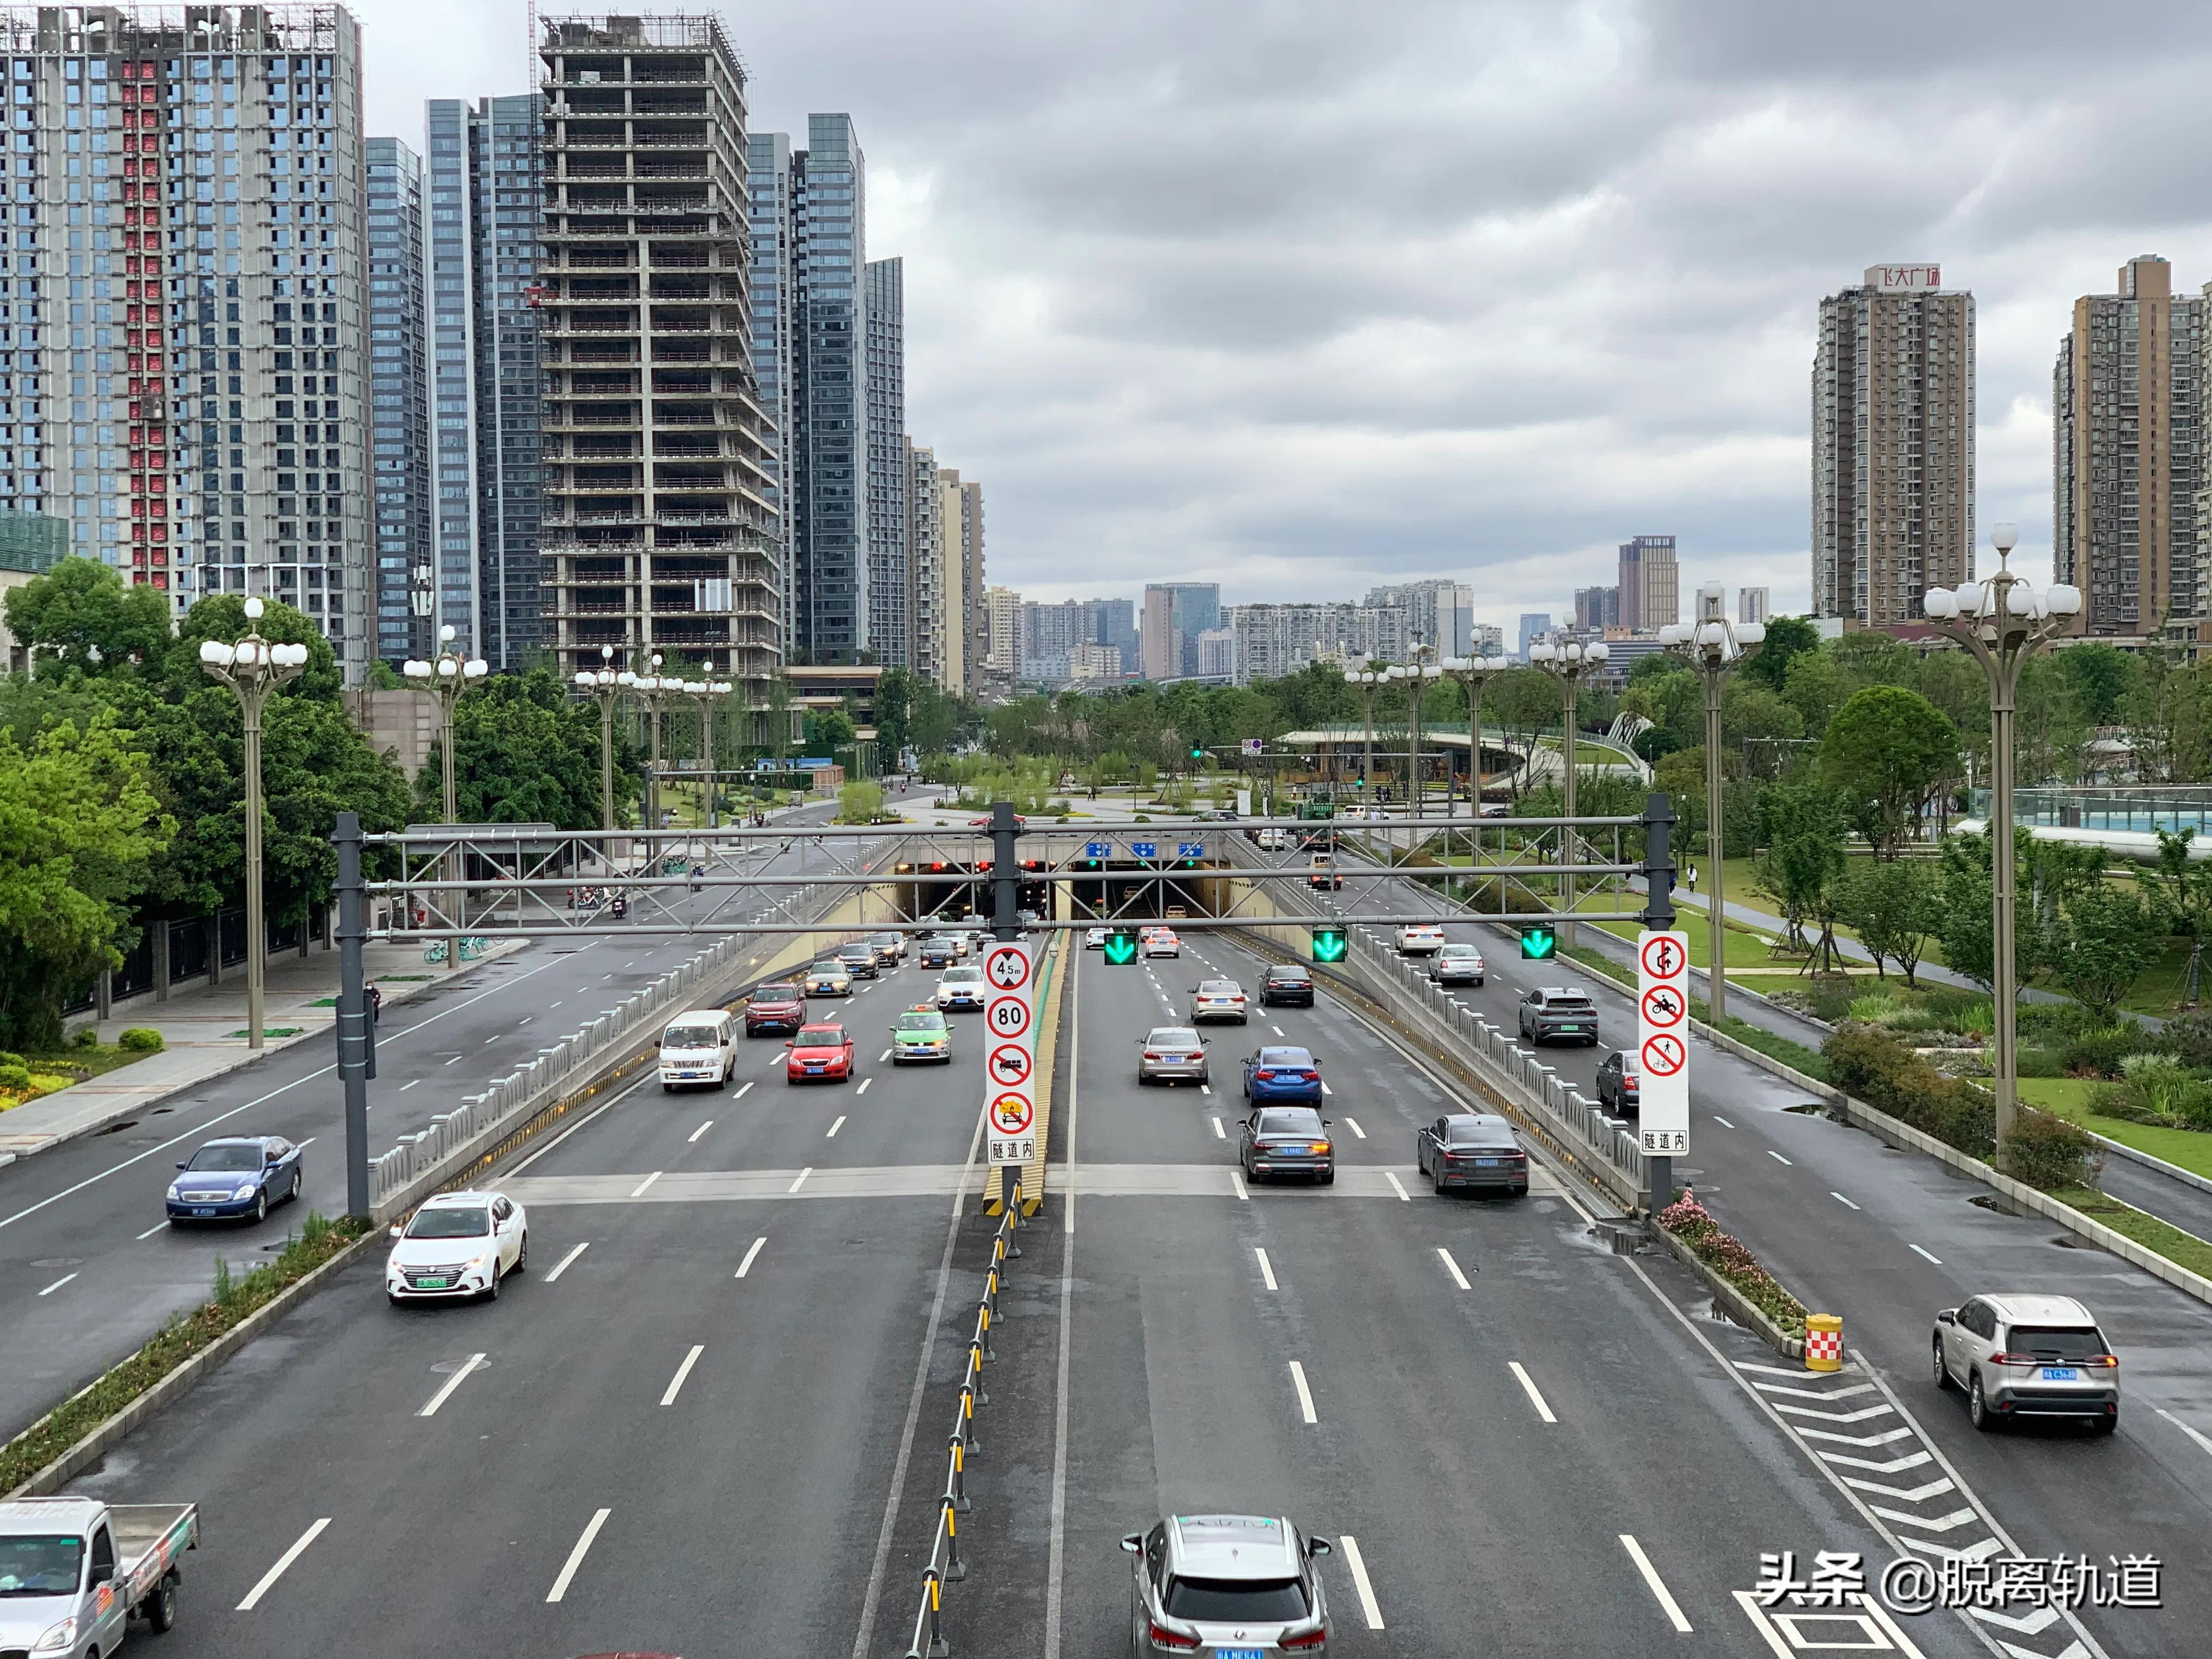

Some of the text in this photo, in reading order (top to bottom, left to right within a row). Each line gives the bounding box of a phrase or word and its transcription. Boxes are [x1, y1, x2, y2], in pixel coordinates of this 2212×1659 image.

[1878, 268, 1940, 286] 飞大广场
[997, 961, 1021, 975] 4.5m
[998, 1007, 1021, 1025] 80
[1645, 1132, 1684, 1149] 隧道内
[993, 1141, 1032, 1159] 隧道内
